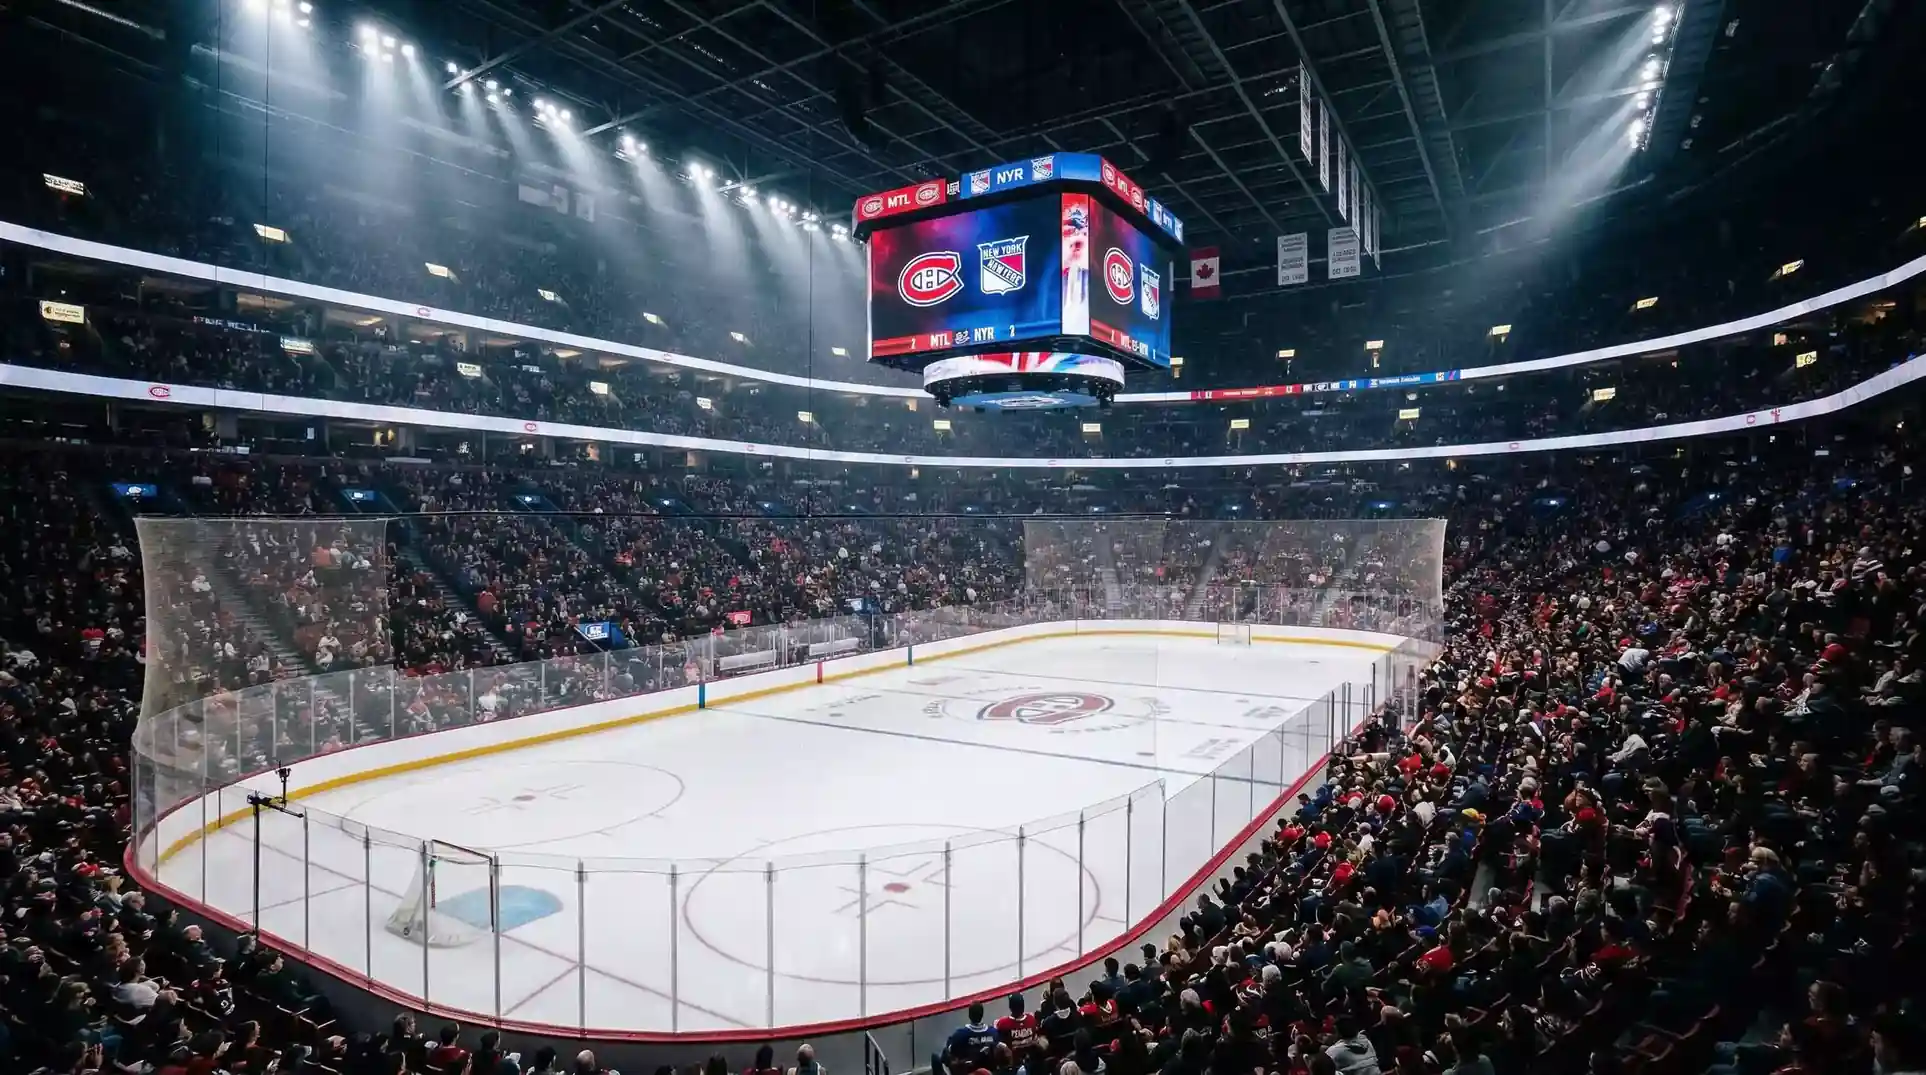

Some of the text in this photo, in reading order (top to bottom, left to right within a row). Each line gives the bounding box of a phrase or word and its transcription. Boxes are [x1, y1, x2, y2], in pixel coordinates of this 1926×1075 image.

[996, 167, 1024, 185] NYR
[887, 193, 911, 209] MTL
[983, 243, 1022, 259] NEW YORK
[930, 332, 950, 348] MTL
[974, 326, 995, 342] NYR
